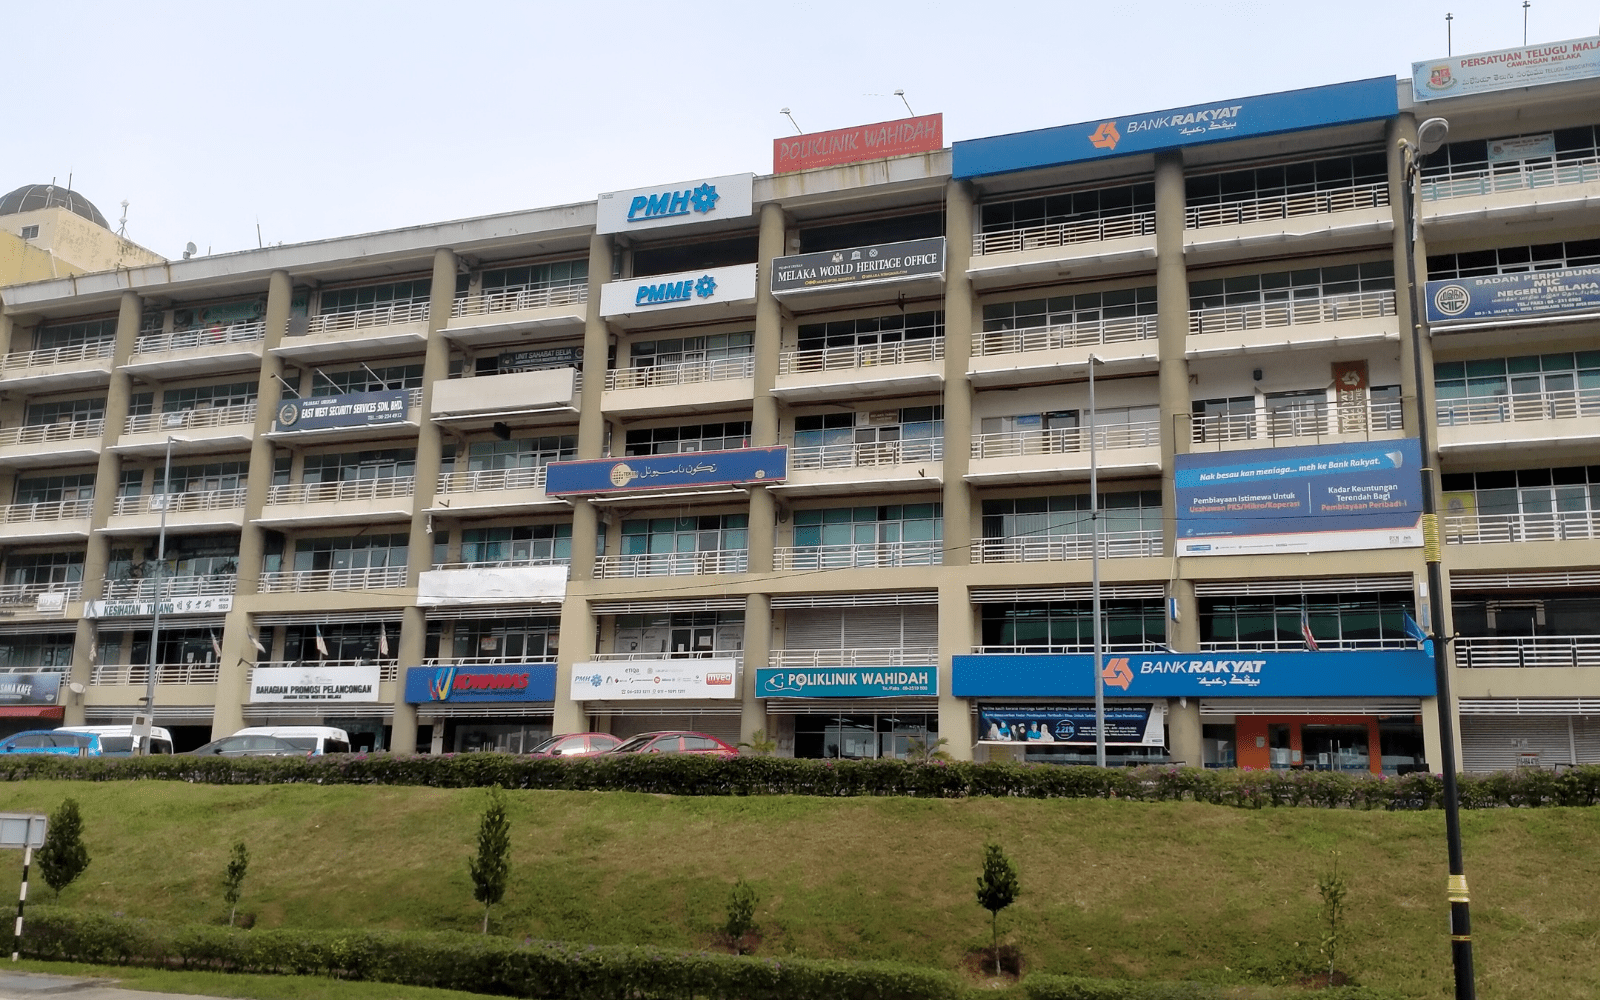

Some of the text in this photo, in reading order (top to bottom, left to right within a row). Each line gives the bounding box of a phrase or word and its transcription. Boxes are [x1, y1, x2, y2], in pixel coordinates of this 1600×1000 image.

[1460, 51, 1522, 69] PERSATUAN
[1525, 45, 1567, 60] TELUGU
[1506, 57, 1548, 68] CAWANGAN
[1551, 52, 1581, 61] MELAKA
[1127, 105, 1243, 133] BANK RAKYAT
[779, 119, 937, 161] POLIKLINIK WAHIDAH
[627, 189, 692, 219] PMH
[778, 267, 817, 282] MELAKA
[819, 263, 854, 278] WORLD
[856, 257, 902, 273] HERITAGE
[904, 253, 937, 267] OFFICE
[1475, 276, 1519, 286] BADAN
[1533, 278, 1561, 287] MIC
[635, 279, 694, 304] PMME
[1497, 282, 1599, 298] NEGERI MELAKA
[529, 351, 555, 359] SAHABAT
[301, 400, 404, 419] EAST WEST SECURITY SERVICES SDN. BHD.
[1199, 473, 1216, 481] Nak
[1216, 470, 1240, 480] besau
[1240, 469, 1255, 478] kan
[1298, 463, 1316, 472] meh
[1317, 462, 1327, 471] ke
[1328, 460, 1350, 470] Bank
[1350, 457, 1380, 469] Rakyat.
[1328, 483, 1398, 494] Kadar Keuntungan
[1193, 491, 1295, 506] Pembiayaan Istimewa Untuk
[1336, 492, 1391, 502] Terendah Bagi
[1189, 501, 1300, 513] Usahawan PKS/Mikro/Koperasi
[1321, 502, 1367, 512] Pembiayaan
[104, 602, 174, 616] KESIHATAN TUANG
[1140, 660, 1267, 674] BANK RAKYAT
[788, 672, 928, 686] POLIKLINIK WAHIDAH
[16, 683, 33, 696] KAFE
[255, 684, 372, 694] BAHAGIAN PROMOSI PELANCONGAN
